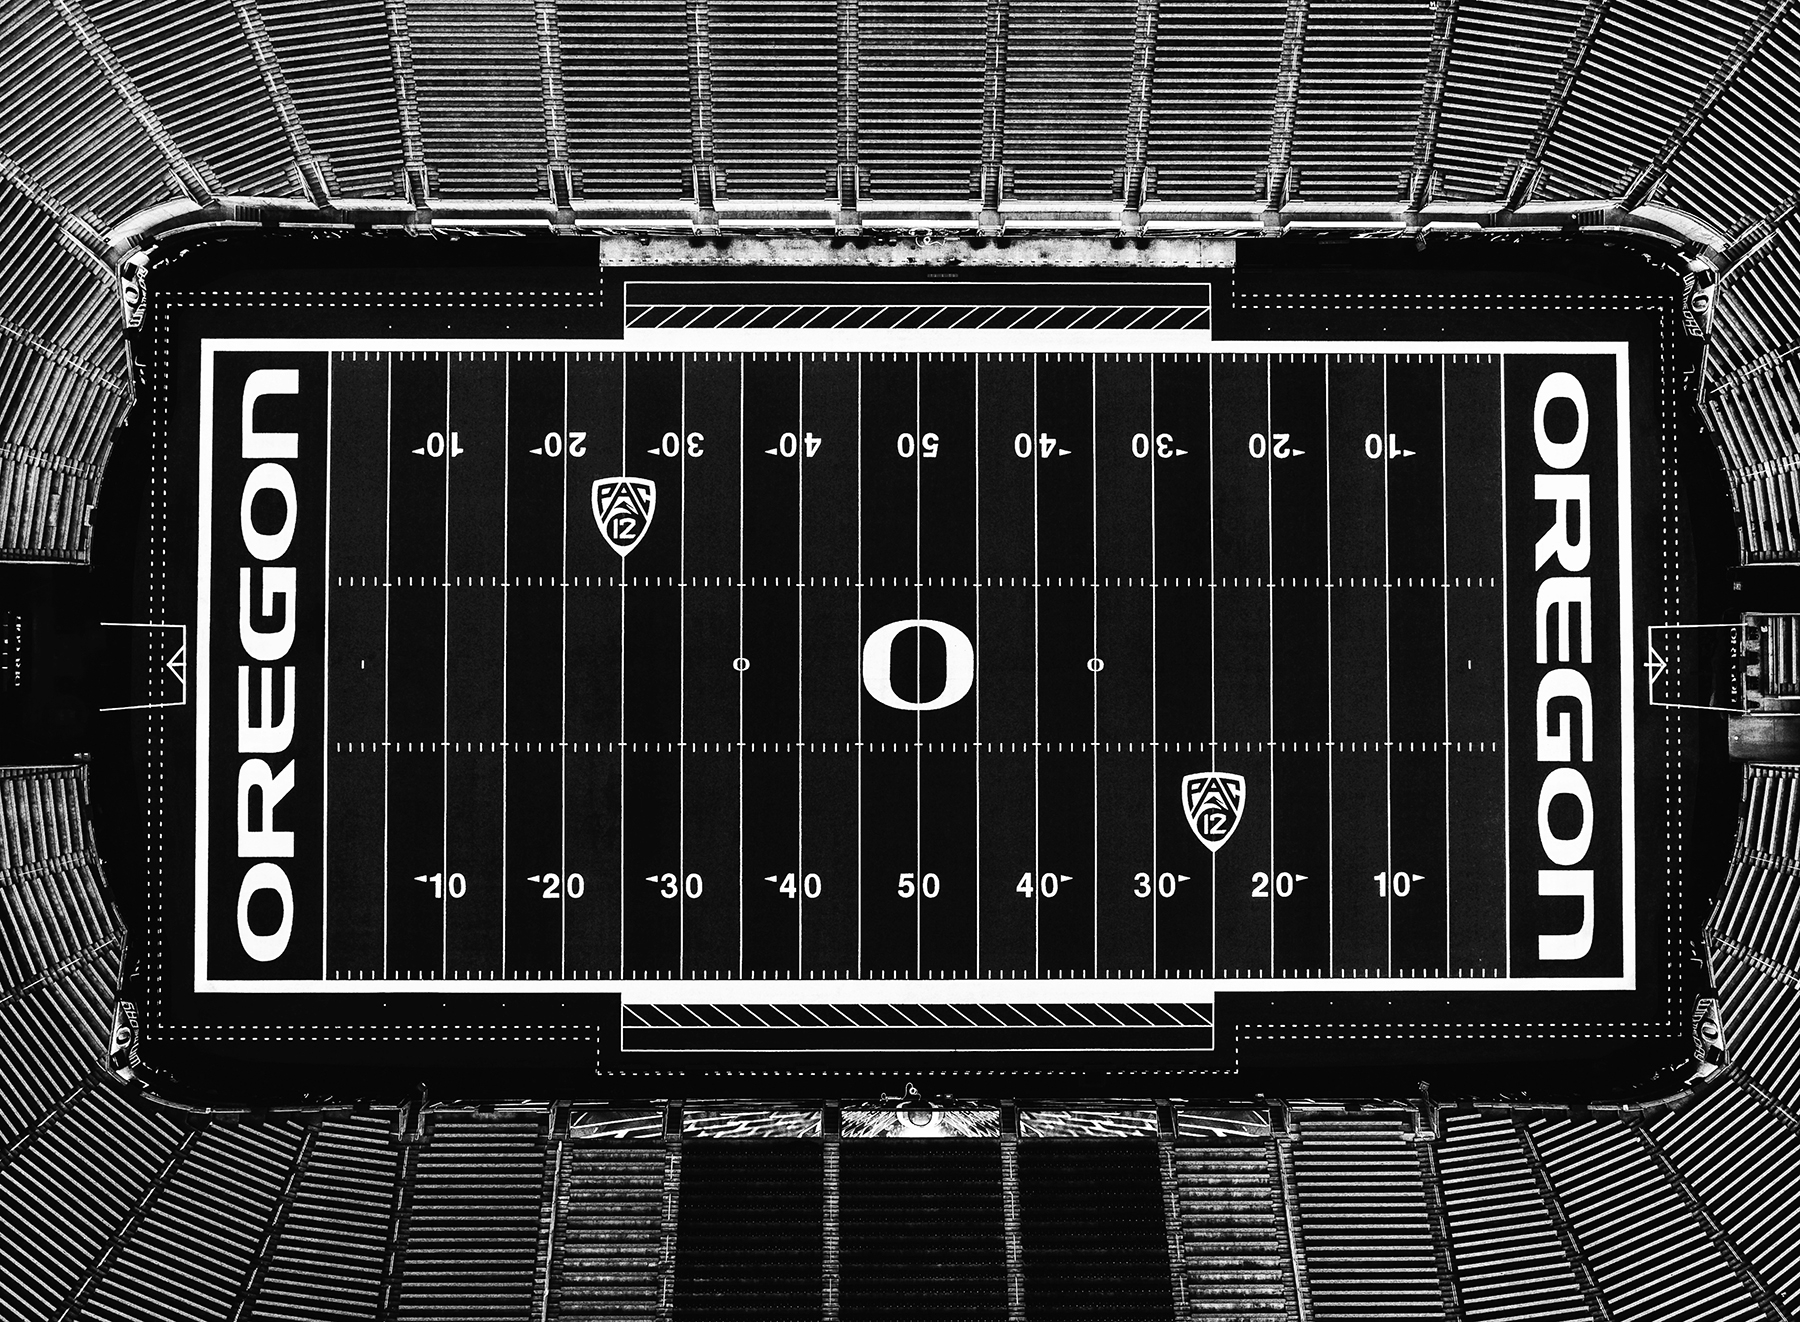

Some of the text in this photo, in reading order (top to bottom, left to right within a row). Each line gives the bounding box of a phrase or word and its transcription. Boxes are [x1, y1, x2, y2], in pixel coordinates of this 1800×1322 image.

[1683, 310, 1705, 338] DAY
[427, 432, 463, 458] 10
[545, 432, 586, 458] 20
[662, 432, 704, 458] 30
[780, 432, 821, 458] 40
[898, 432, 939, 458] 50
[1015, 432, 1056, 458] 40
[1132, 432, 1173, 458] 30
[1249, 432, 1290, 458] 20
[1365, 432, 1401, 458] 10
[597, 482, 650, 524] PAC
[613, 518, 637, 539] 12
[237, 369, 299, 961] OREGON
[1534, 372, 1595, 960] OREGON
[1187, 778, 1240, 819] PAC
[1203, 813, 1227, 834] 12
[430, 872, 466, 898] 10
[543, 872, 584, 898] 20
[661, 872, 702, 898] 30
[780, 872, 821, 898] 40
[898, 872, 939, 898] 50
[1017, 872, 1058, 898] 40
[1134, 872, 1175, 898] 30
[1252, 872, 1293, 898] 20
[1374, 872, 1410, 898] 10
